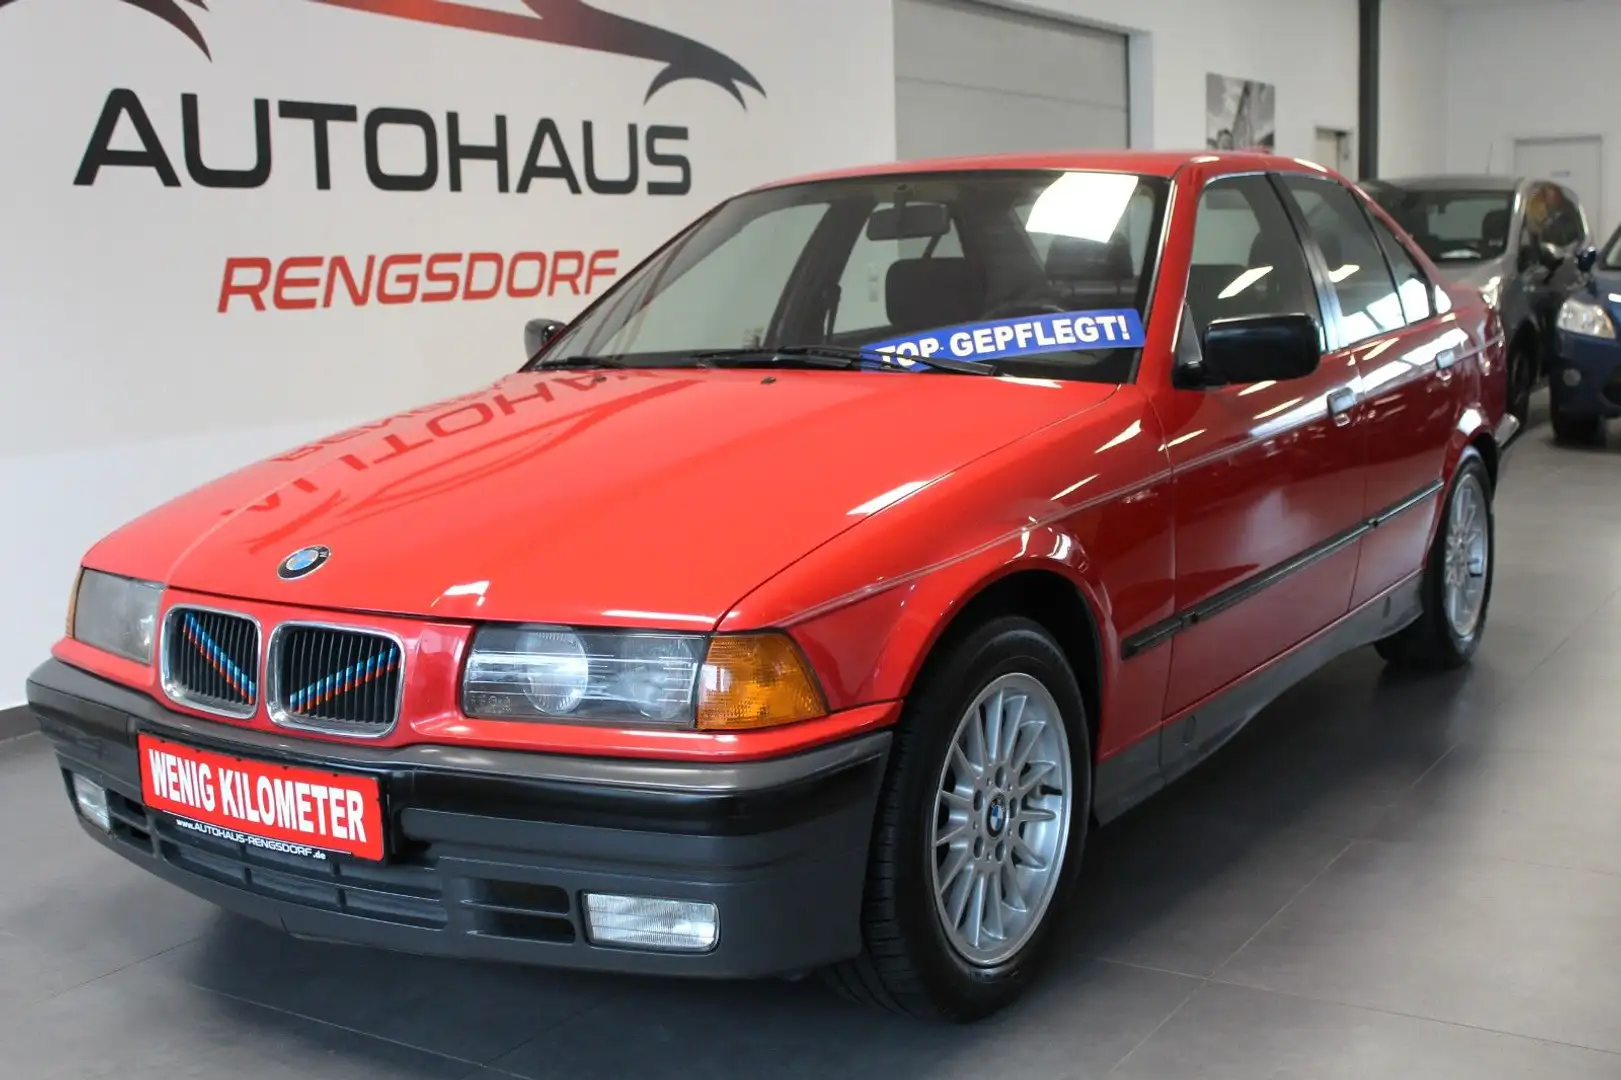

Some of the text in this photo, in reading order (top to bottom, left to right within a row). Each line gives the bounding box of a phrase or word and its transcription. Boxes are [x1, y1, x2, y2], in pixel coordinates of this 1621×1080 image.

[73, 87, 692, 196] AUTOHAUS
[218, 249, 619, 313] RENGSDORF
[950, 315, 1129, 357] GEPFLEGT!
[148, 749, 367, 842] WENIG KILOMETER
